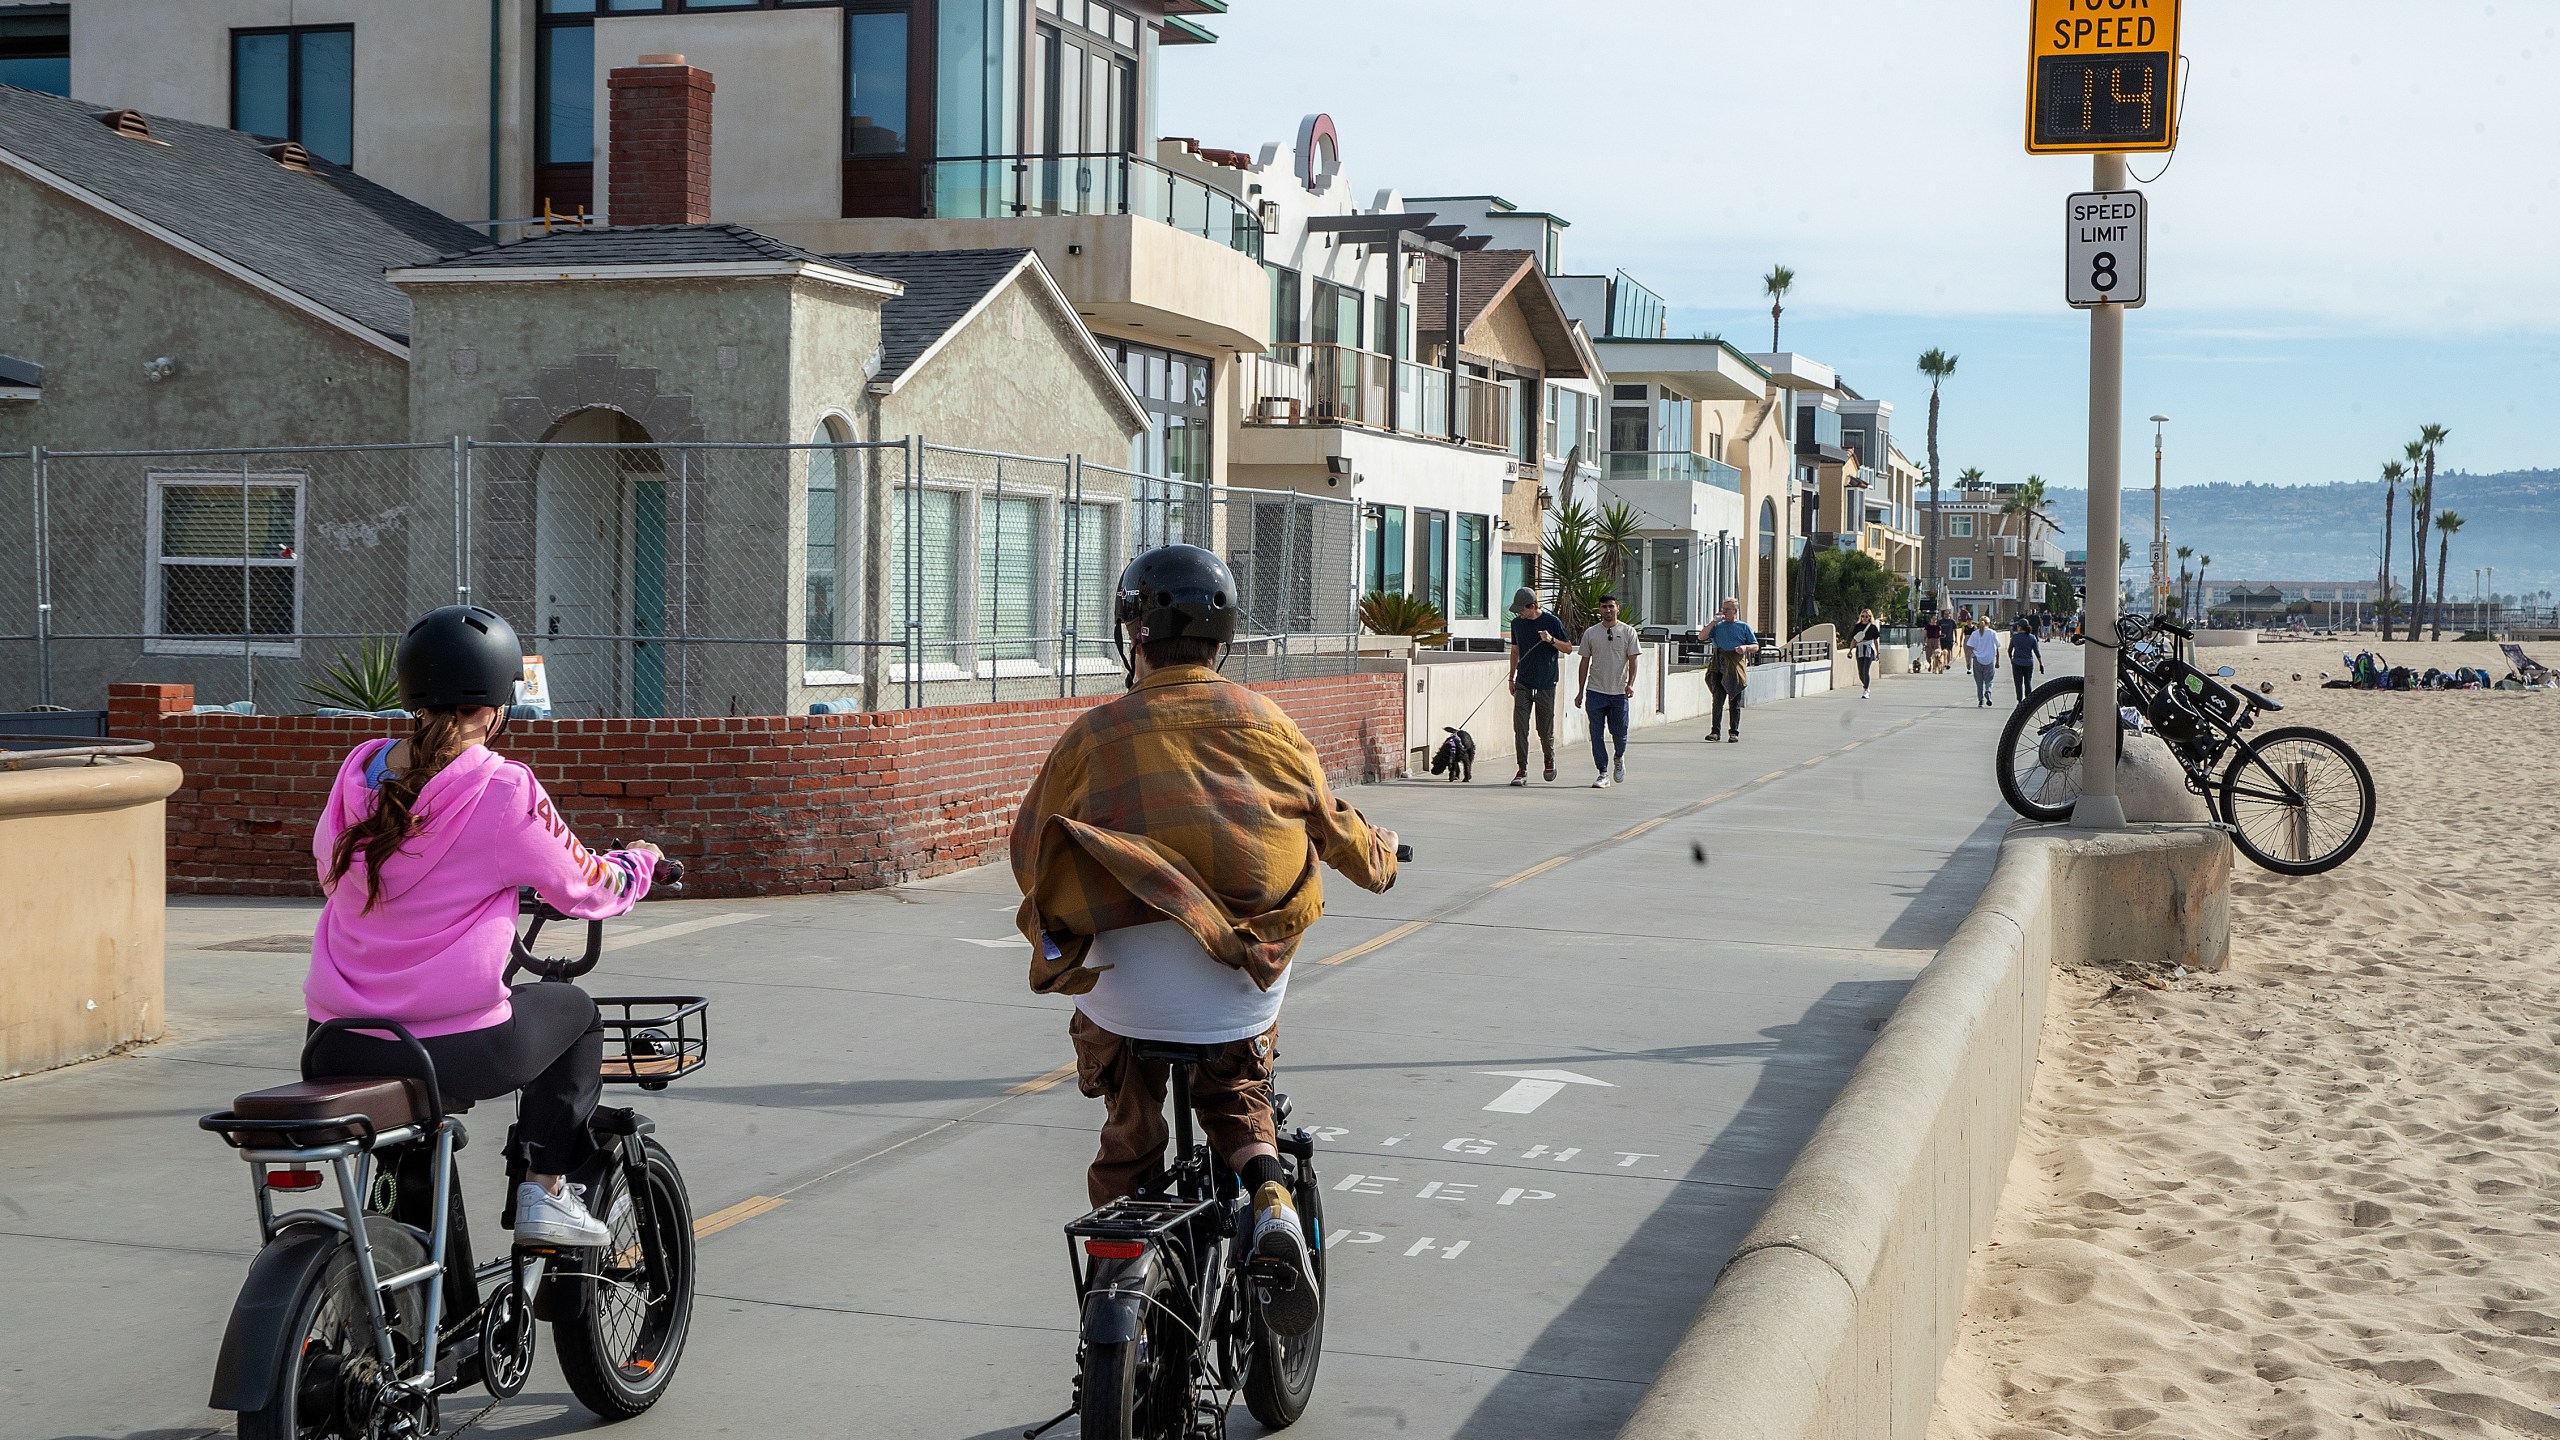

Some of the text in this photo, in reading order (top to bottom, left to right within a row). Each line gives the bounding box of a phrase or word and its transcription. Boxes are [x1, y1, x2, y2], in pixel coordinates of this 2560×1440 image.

[2053, 16, 2156, 50] SPEED
[2083, 67, 2153, 131] 14
[2073, 203, 2137, 221] SPEED
[2081, 225, 2129, 243] LIMIT
[2090, 251, 2118, 292] 8
[2153, 552, 2160, 560] 8
[1302, 1125, 1660, 1168] RIGHT
[1314, 1170, 1557, 1206] EEP
[1326, 1228, 1471, 1260] PH
